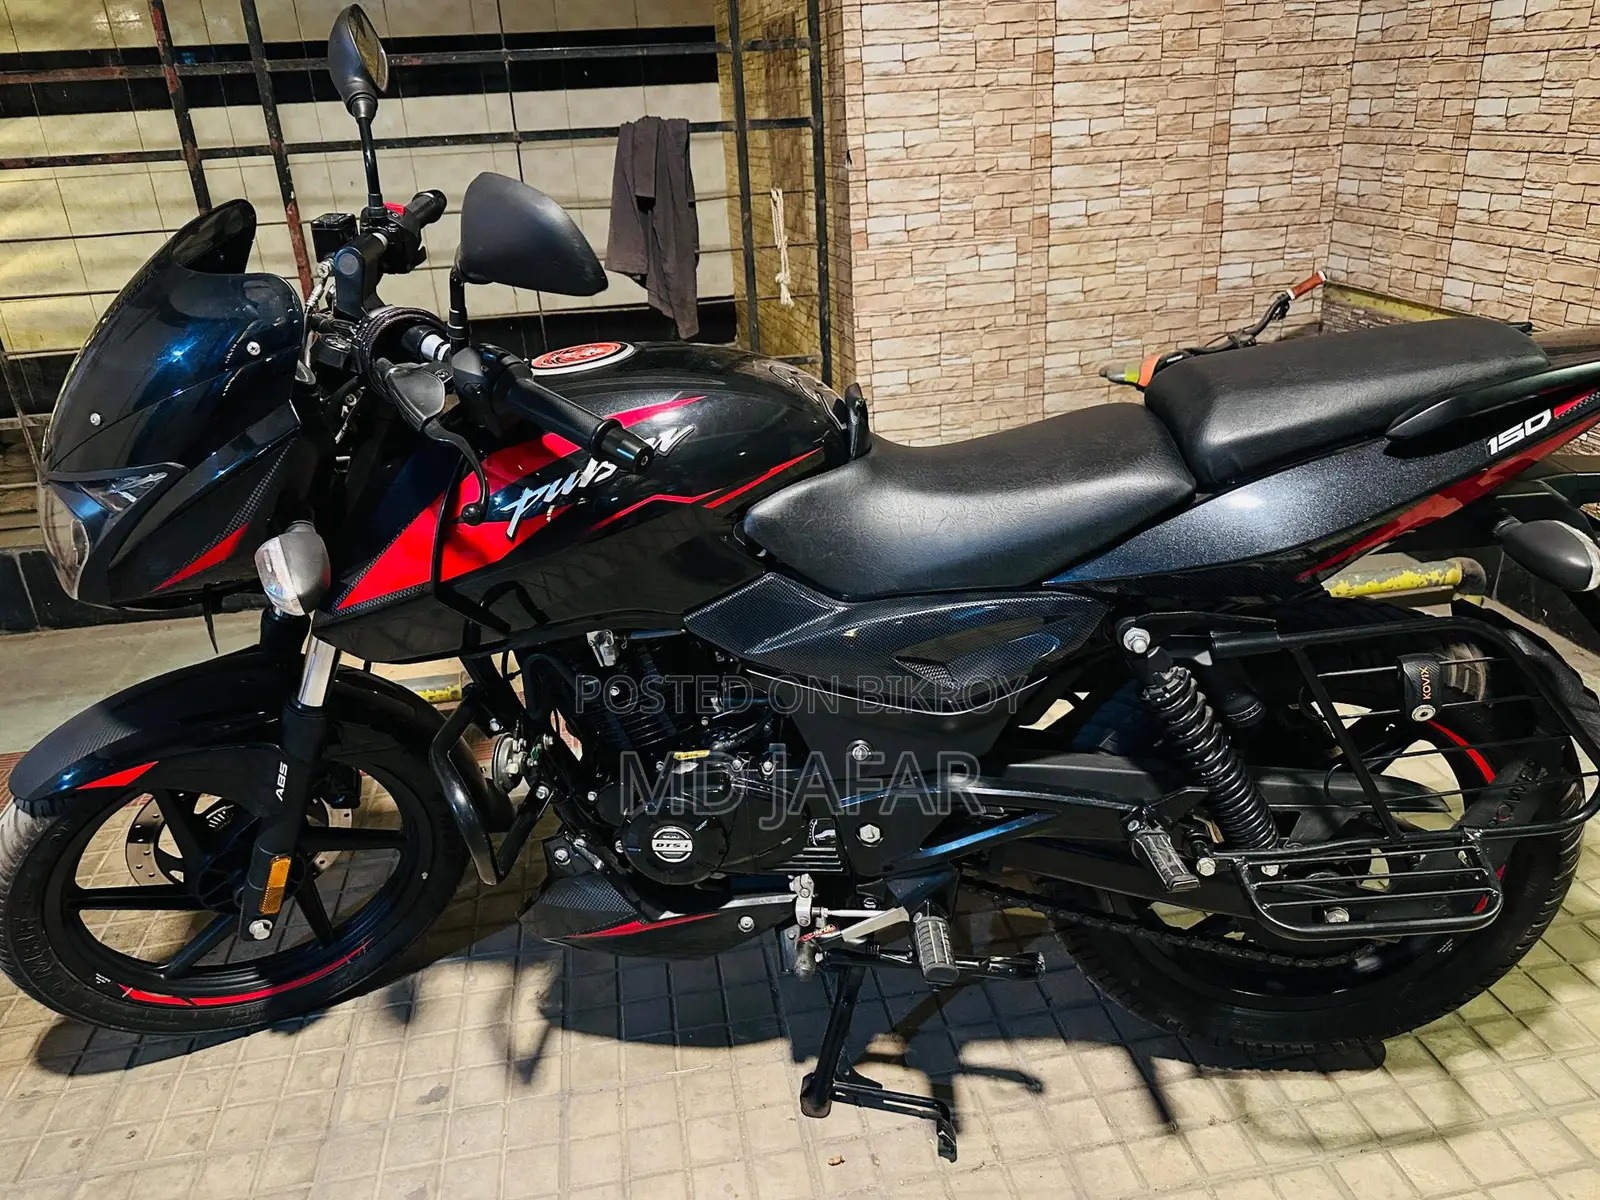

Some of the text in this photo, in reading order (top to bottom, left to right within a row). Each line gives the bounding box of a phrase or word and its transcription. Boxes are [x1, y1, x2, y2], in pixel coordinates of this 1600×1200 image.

[1487, 408, 1552, 456] 150
[499, 424, 697, 539] pulsr
[275, 761, 289, 802] ABS
